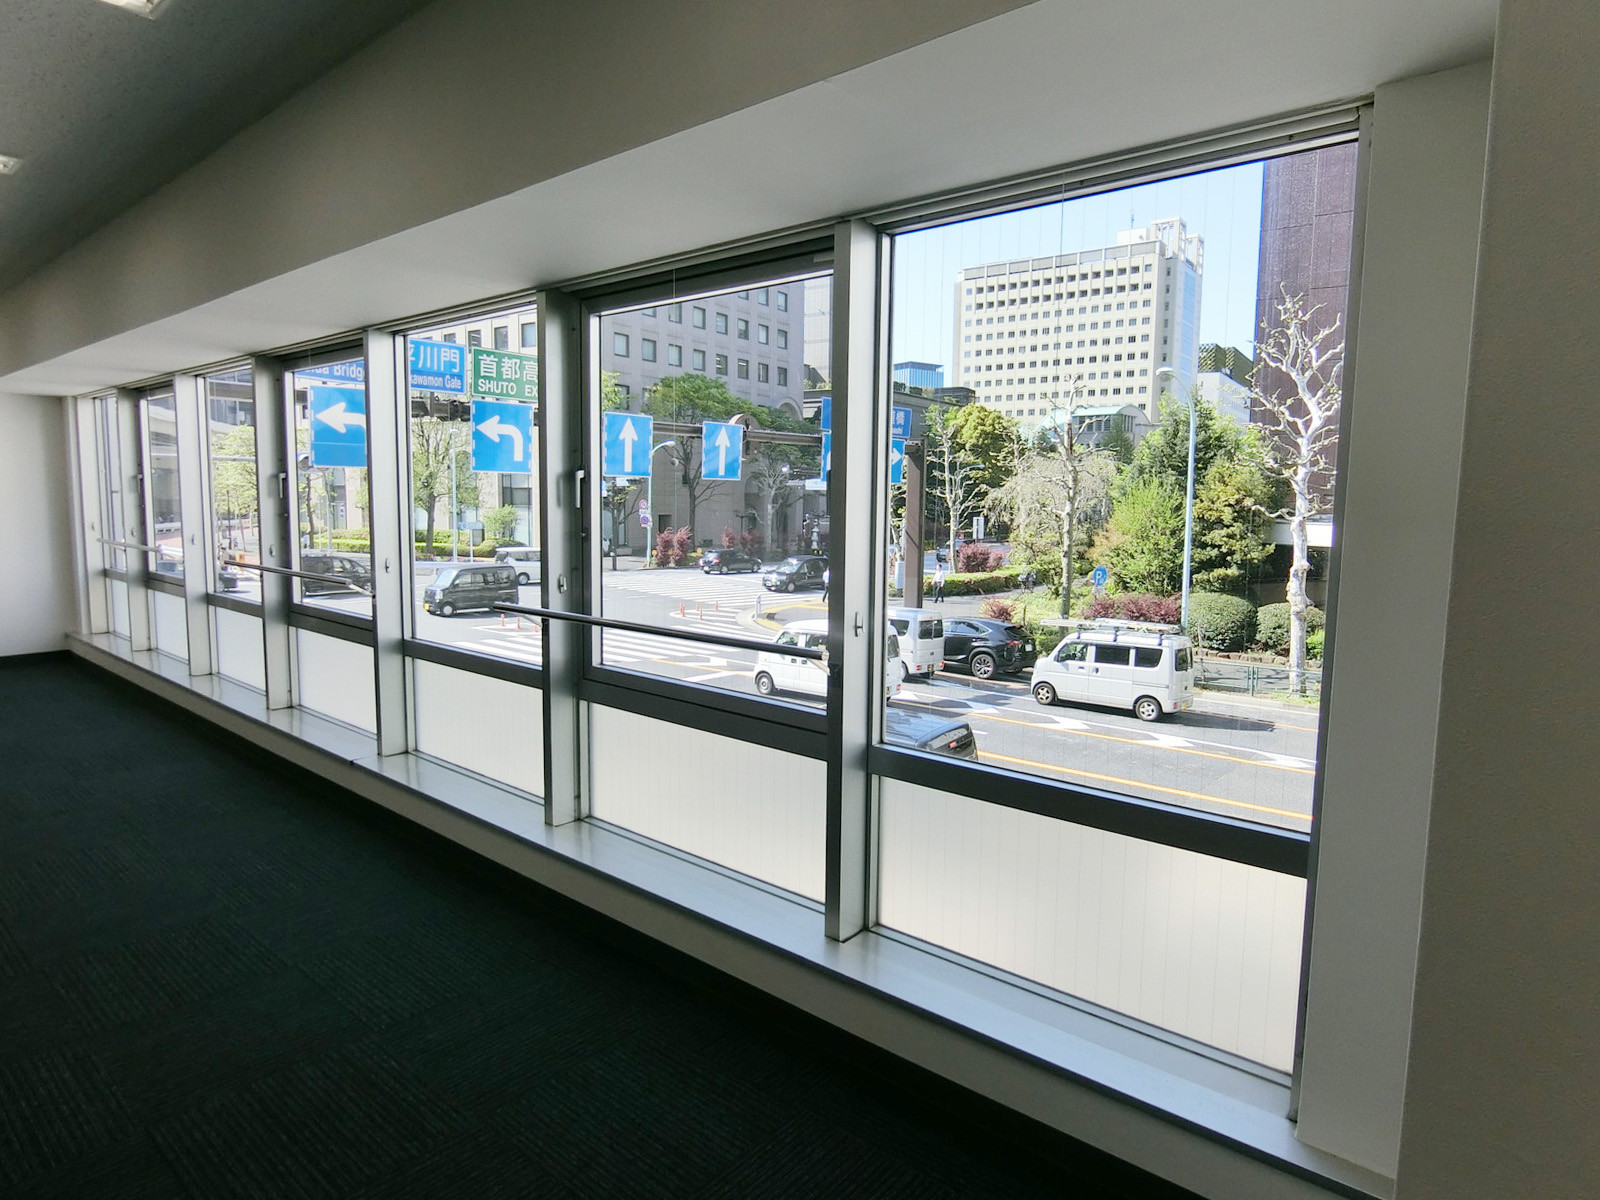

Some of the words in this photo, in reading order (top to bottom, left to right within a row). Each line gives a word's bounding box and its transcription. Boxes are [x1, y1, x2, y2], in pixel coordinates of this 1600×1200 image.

[333, 363, 365, 381] Bridg
[445, 375, 462, 389] Gate
[478, 378, 517, 395] SHUTO
